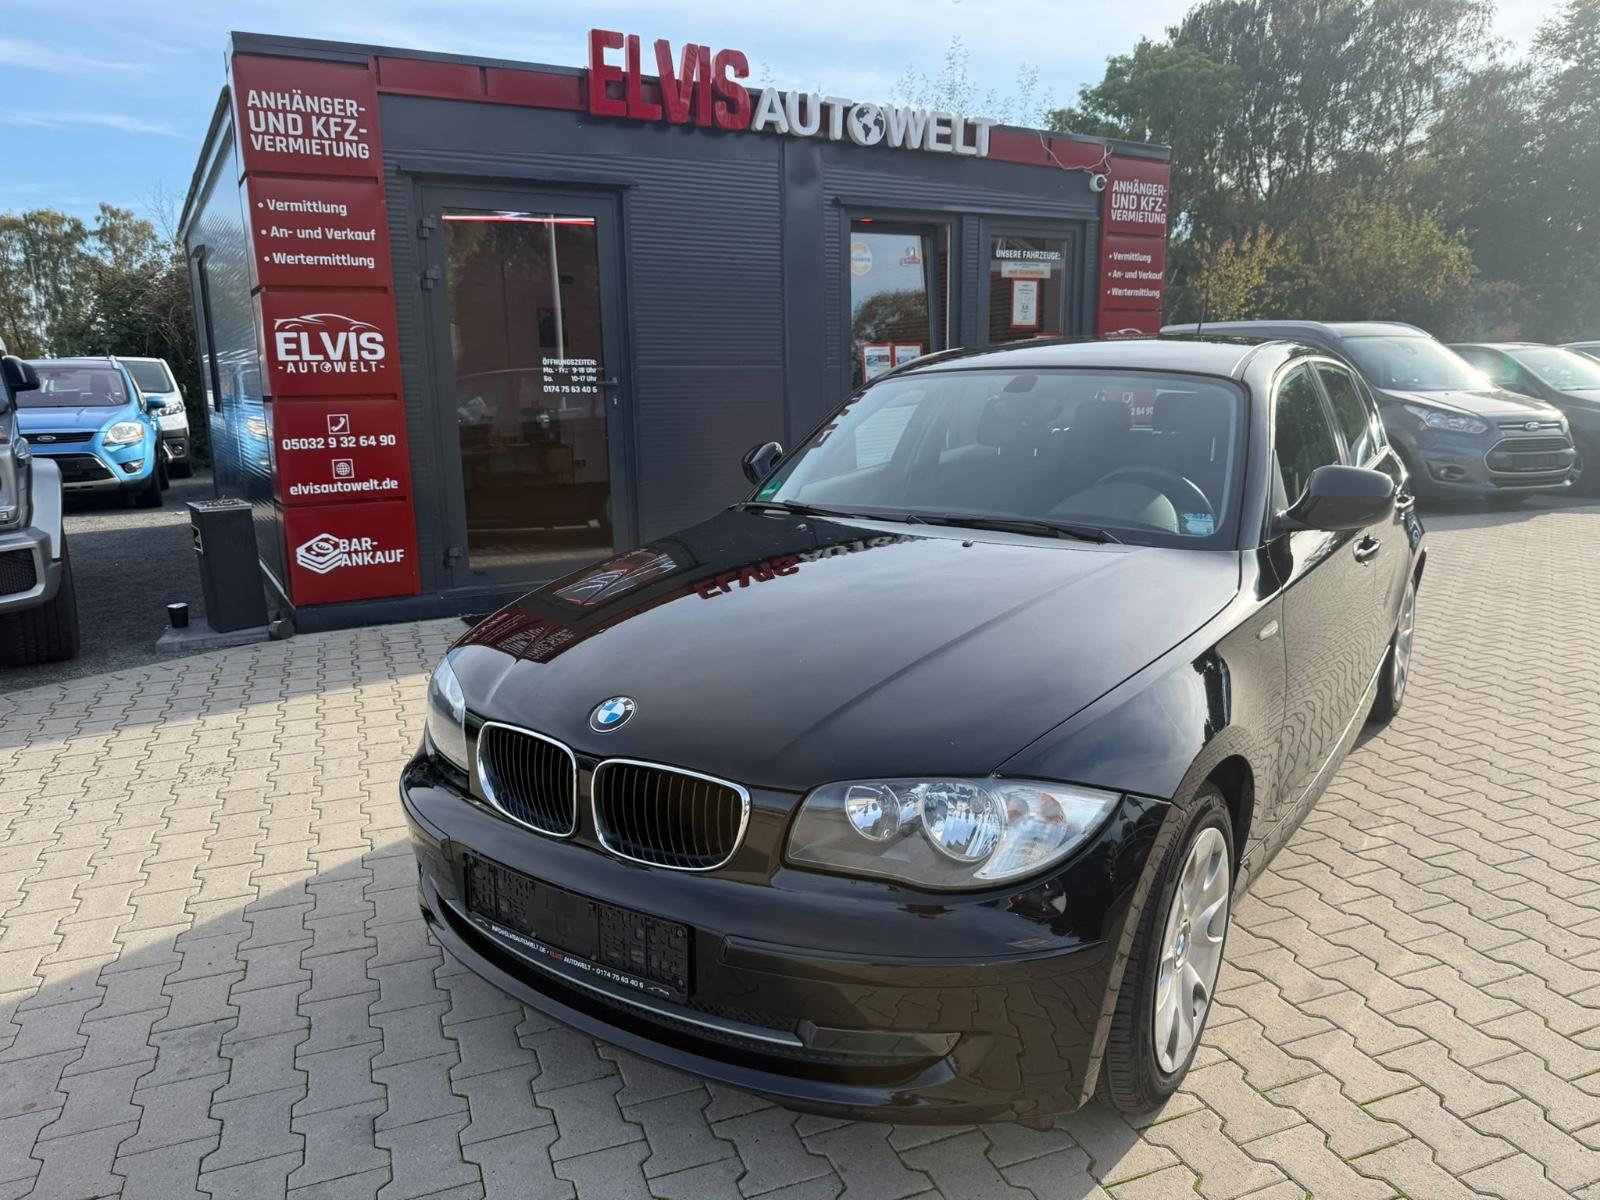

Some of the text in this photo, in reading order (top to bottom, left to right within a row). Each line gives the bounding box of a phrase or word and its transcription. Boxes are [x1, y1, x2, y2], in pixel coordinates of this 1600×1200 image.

[588, 28, 998, 158] ELVIS AUTOWELT
[247, 89, 366, 118] ANHÄNGER-
[248, 109, 368, 141] UND KFZ-
[250, 134, 370, 160] VERMIETUNG
[1112, 179, 1168, 197] ANHÄNGER-
[266, 199, 348, 217] Vermittlung
[1111, 193, 1167, 212] UND KFZ-
[1111, 209, 1167, 225] VERMIETUNG
[270, 226, 376, 241] An- und Verkauf
[272, 252, 375, 269] Wertermittlung
[996, 249, 1022, 259] UNSERE
[1113, 251, 1152, 264] Vermittlung
[1112, 270, 1164, 281] An- und Verkauf
[1111, 287, 1160, 299] Wertermittlung
[275, 331, 386, 362] ELVIS
[542, 356, 597, 366] ÖFFNUNGSZEITEN:
[586, 366, 597, 374] Uhr
[543, 385, 560, 393] 0174
[561, 385, 570, 393] 75
[581, 385, 591, 393] 40
[282, 434, 396, 450] 05032 9 32 64 90
[289, 477, 399, 496] elvisautowelt.de
[339, 537, 378, 552] BAR-
[340, 549, 405, 568] ANKAUF
[563, 956, 591, 972] AUTOWELT
[595, 967, 611, 979] 0174
